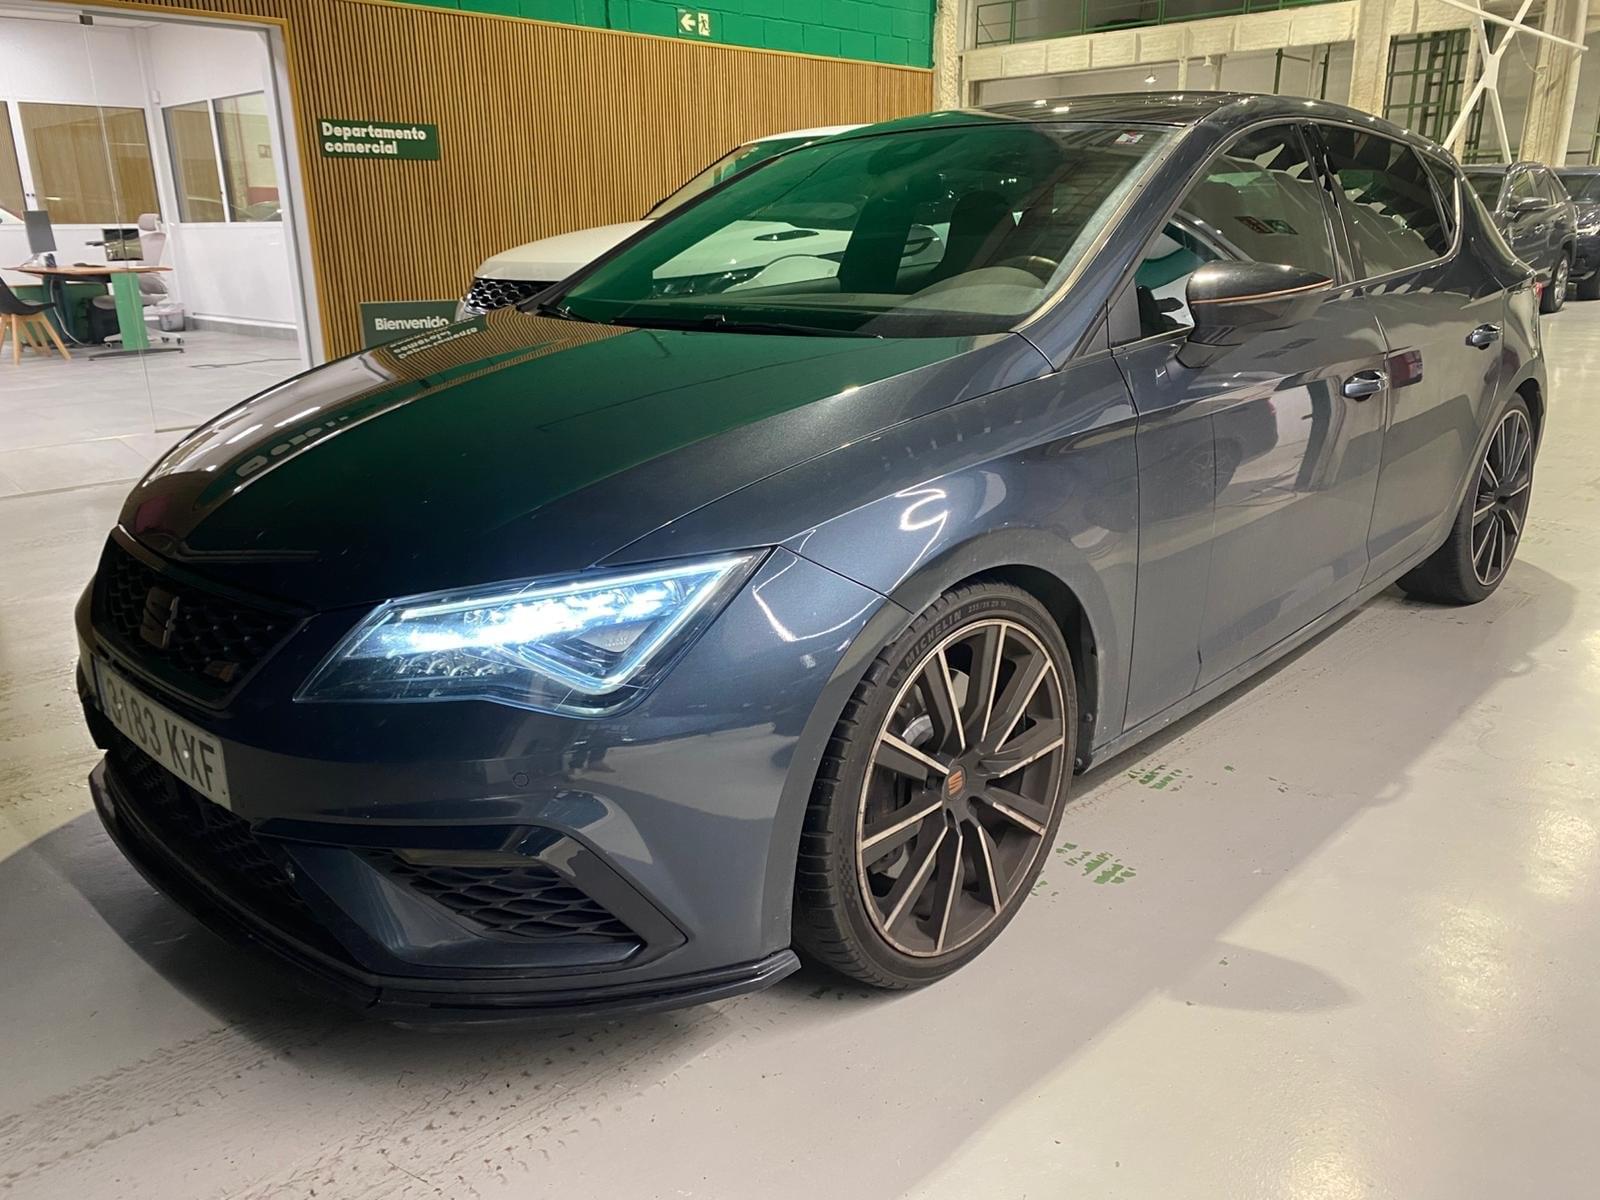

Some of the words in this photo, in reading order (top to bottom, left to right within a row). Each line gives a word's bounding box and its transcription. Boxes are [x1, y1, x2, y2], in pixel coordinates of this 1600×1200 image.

[321, 122, 427, 140] Departamento
[324, 140, 398, 154] comercial
[374, 316, 449, 331] Bienvenido
[903, 608, 963, 666] MICHELIN
[164, 719, 216, 793] KXF
